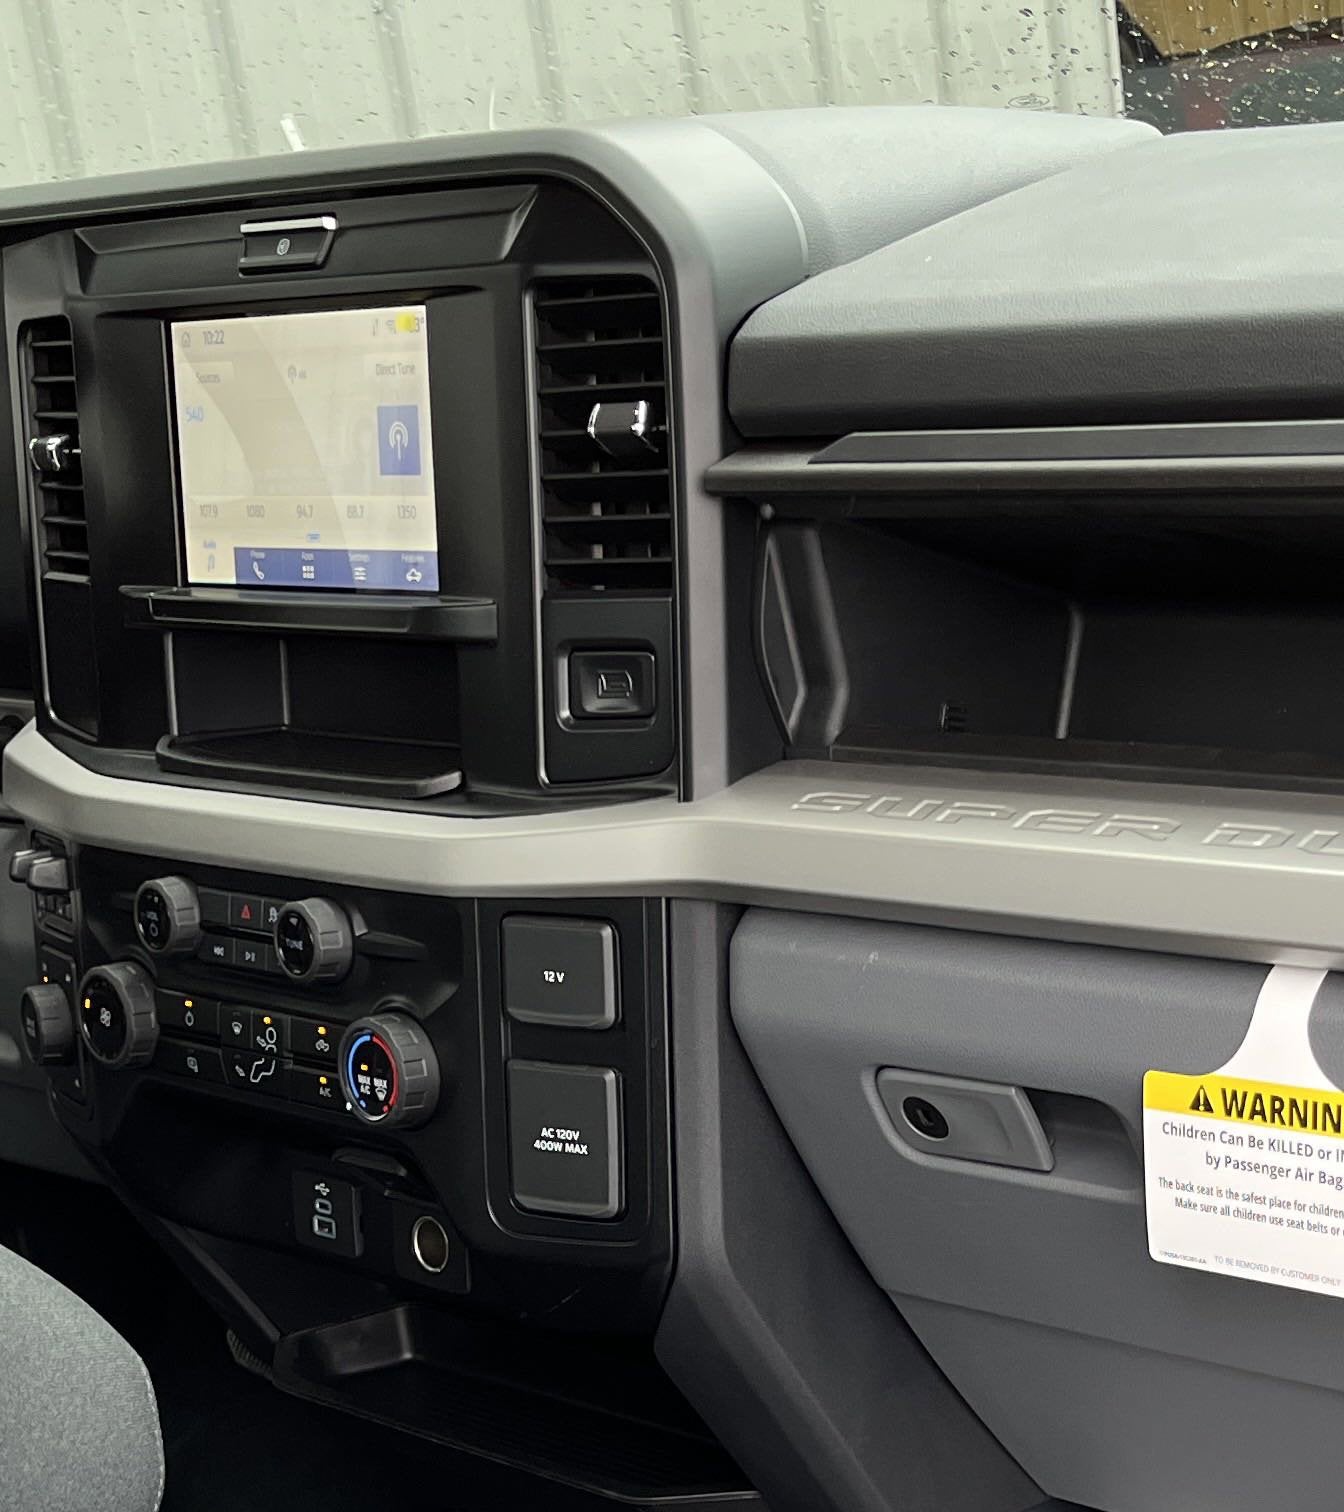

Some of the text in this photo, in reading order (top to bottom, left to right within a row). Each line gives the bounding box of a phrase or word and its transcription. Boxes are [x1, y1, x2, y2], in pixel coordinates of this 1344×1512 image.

[790, 789, 1183, 843] SUPER
[544, 970, 565, 983] 12 V
[534, 1140, 588, 1155] 400W MAX
[541, 1127, 580, 1141] AC 120V
[1162, 1121, 1215, 1143] Children
[1219, 1131, 1243, 1147] Can
[1248, 1135, 1264, 1150] Be
[1268, 1138, 1313, 1158] KILLED
[1318, 1149, 1331, 1160] or
[1206, 1152, 1220, 1169] by
[1224, 1155, 1291, 1180] Passenger
[1295, 1167, 1314, 1182] Air
[1159, 1177, 1173, 1190] The
[1175, 1179, 1194, 1193] back
[1197, 1184, 1213, 1196] seat
[1216, 1187, 1224, 1198] is
[1226, 1188, 1240, 1201] the
[1242, 1190, 1267, 1206] safest
[1269, 1196, 1291, 1212] place
[1294, 1199, 1307, 1213] for
[1309, 1202, 1344, 1219] children
[1175, 1198, 1197, 1211] Make
[1200, 1204, 1218, 1215] sure
[1220, 1205, 1230, 1217] all
[1232, 1207, 1266, 1223] children
[1269, 1215, 1283, 1226] use
[1286, 1217, 1304, 1230] seat
[1307, 1220, 1328, 1234] belts
[1331, 1226, 1340, 1237] or
